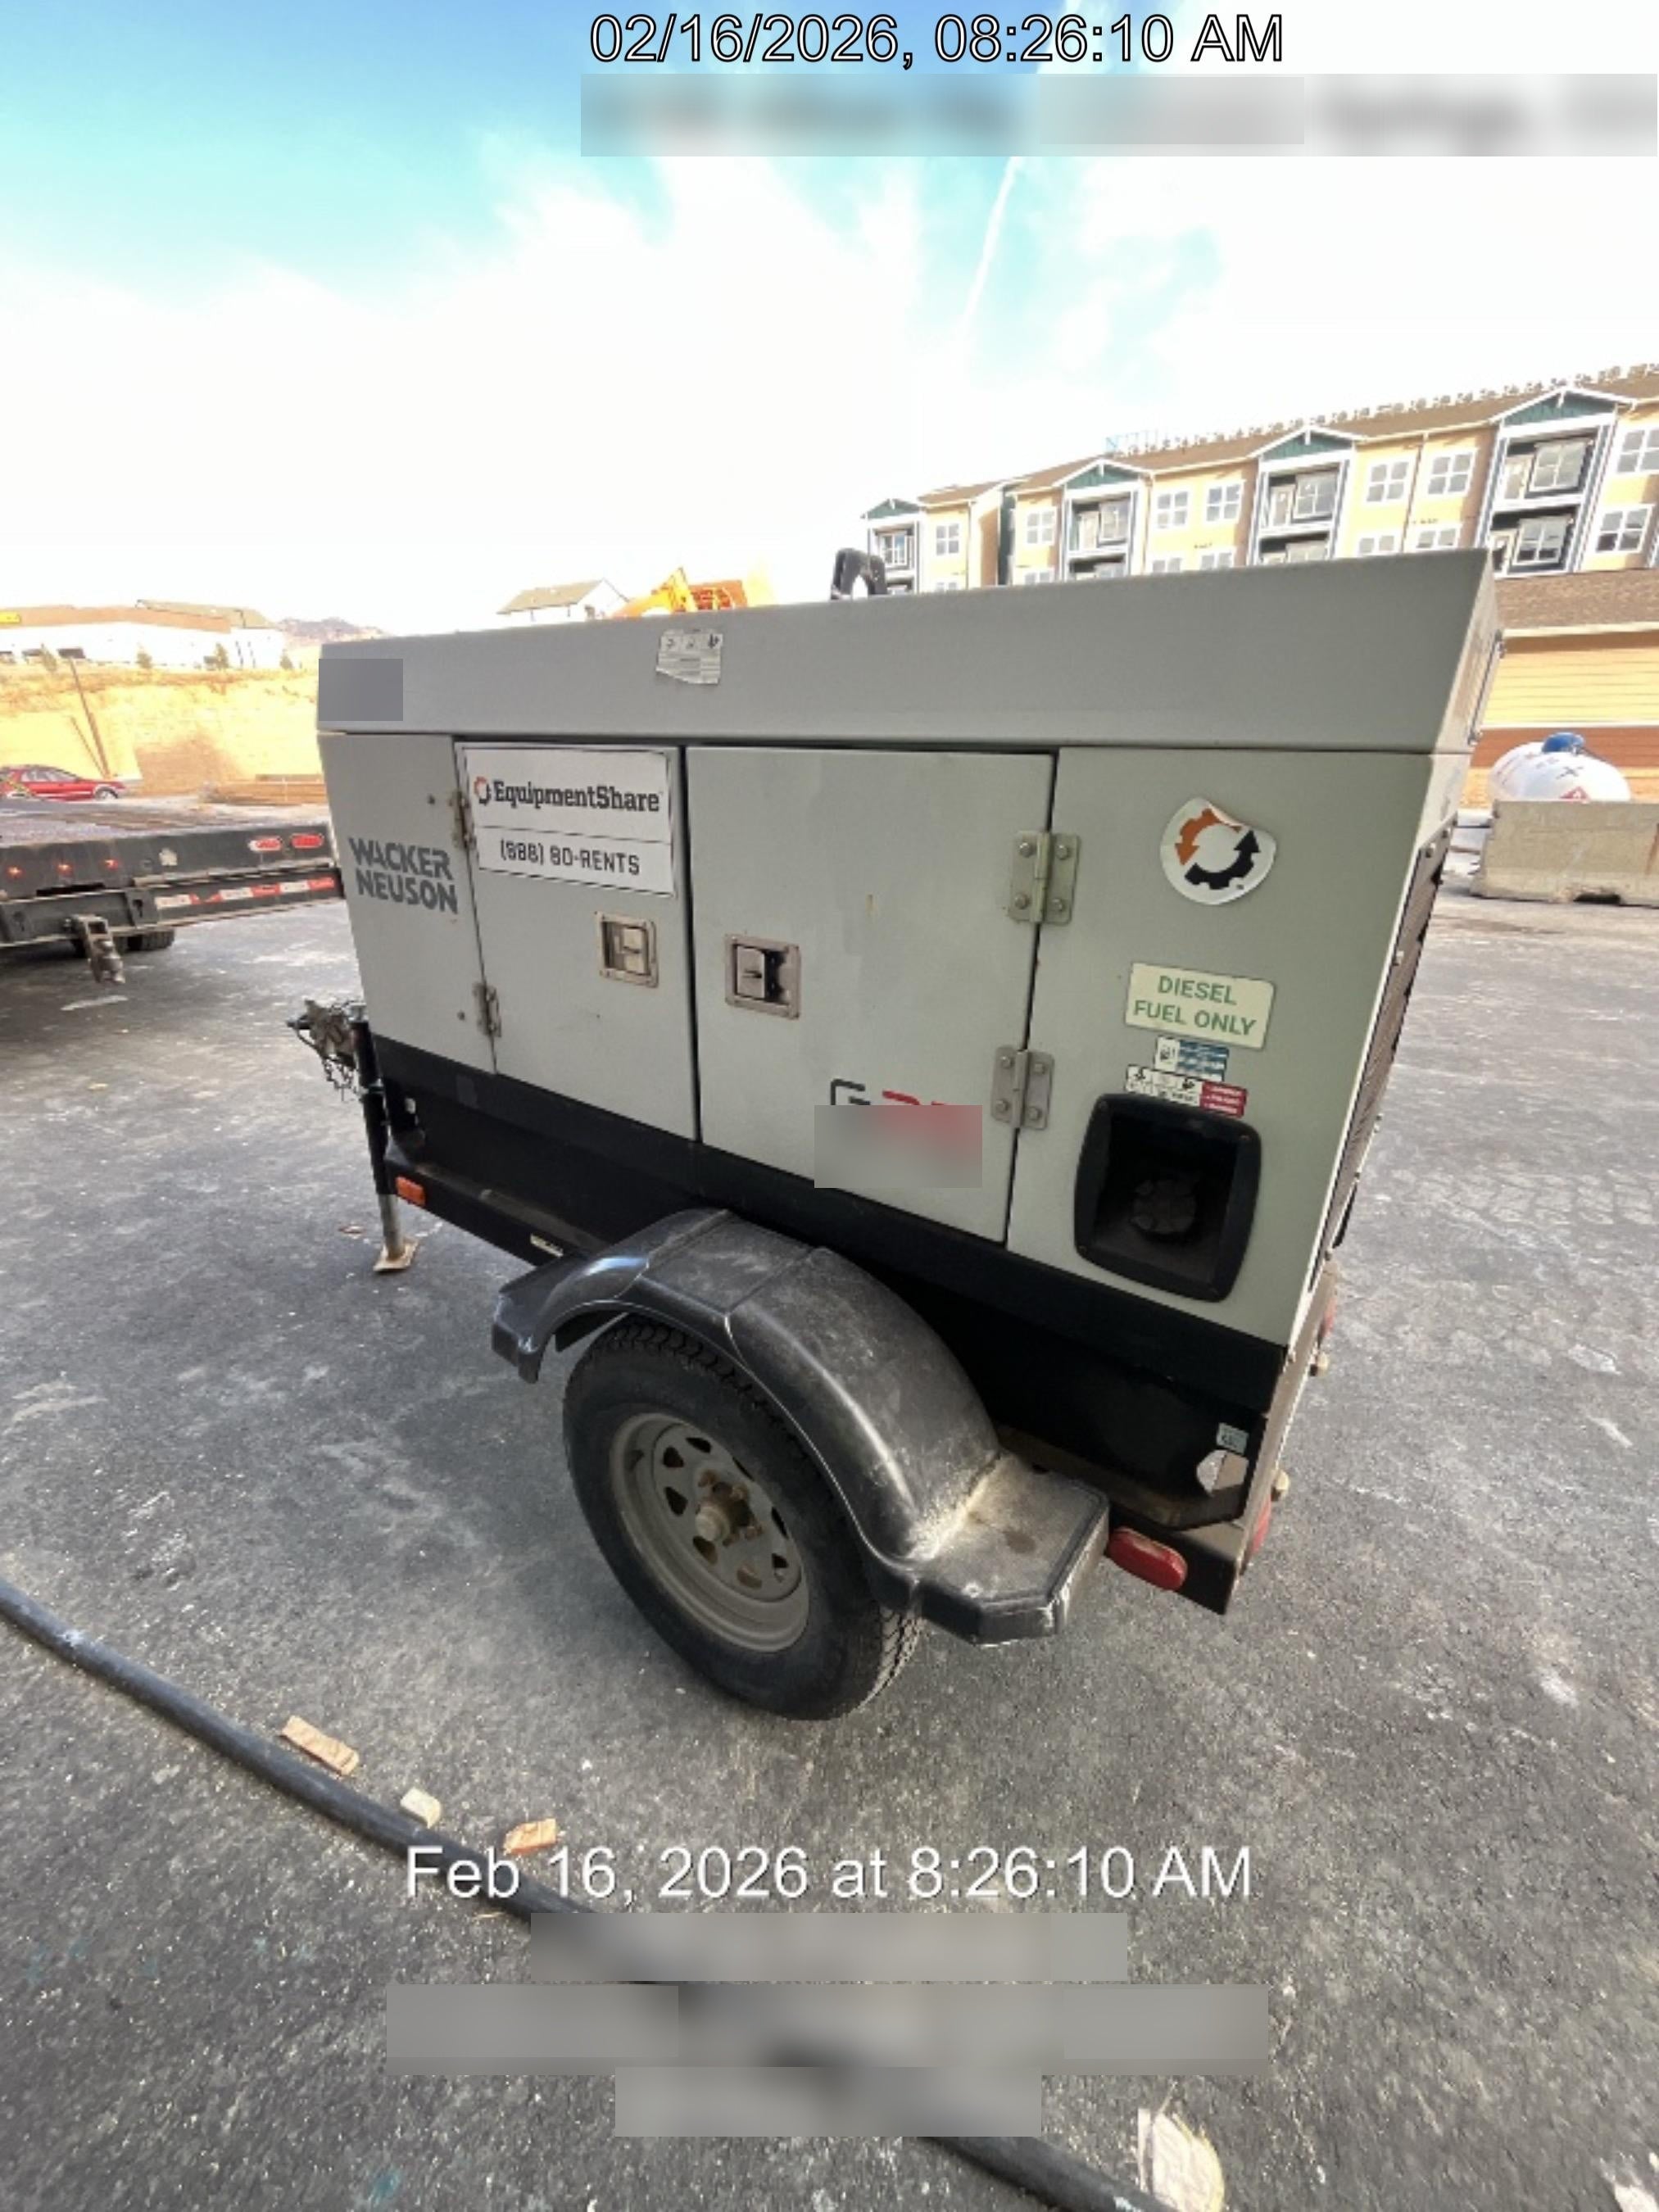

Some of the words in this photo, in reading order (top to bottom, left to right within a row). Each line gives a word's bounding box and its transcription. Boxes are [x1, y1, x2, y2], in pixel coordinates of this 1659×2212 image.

[493, 781, 660, 812] EquipmentShare
[348, 837, 453, 881] WACKER
[550, 845, 639, 876] 80-RENTS
[356, 867, 458, 915] NEUSON
[1158, 975, 1237, 1006] DIESEL
[1133, 999, 1187, 1025] FUEL
[1194, 1009, 1257, 1036] ONLY
